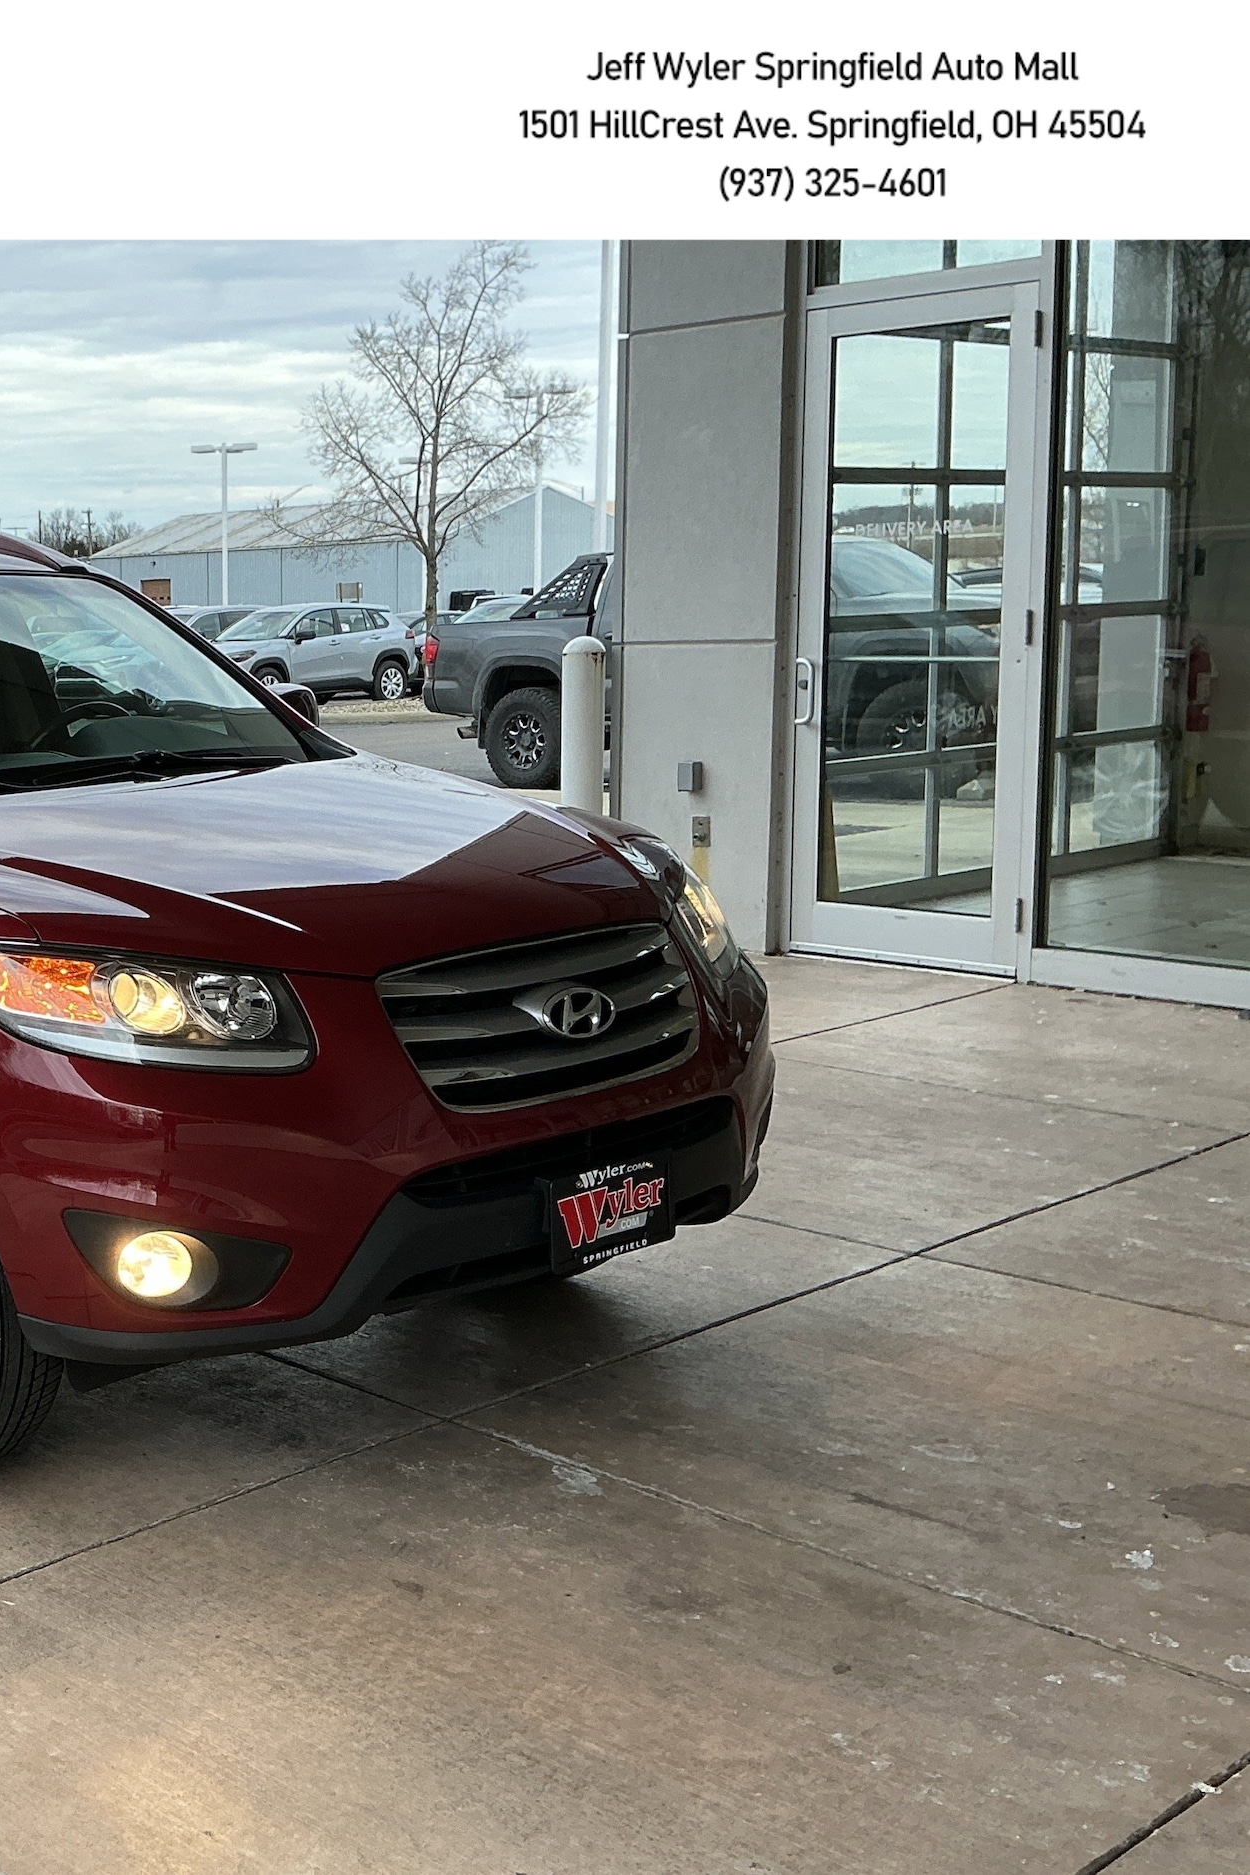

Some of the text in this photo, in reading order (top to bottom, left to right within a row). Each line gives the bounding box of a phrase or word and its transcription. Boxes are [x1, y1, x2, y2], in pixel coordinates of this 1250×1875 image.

[855, 518, 974, 537] DELIVERY AREA
[557, 1177, 665, 1249] Wyler
[582, 1239, 648, 1264] SPRINGFIELD
